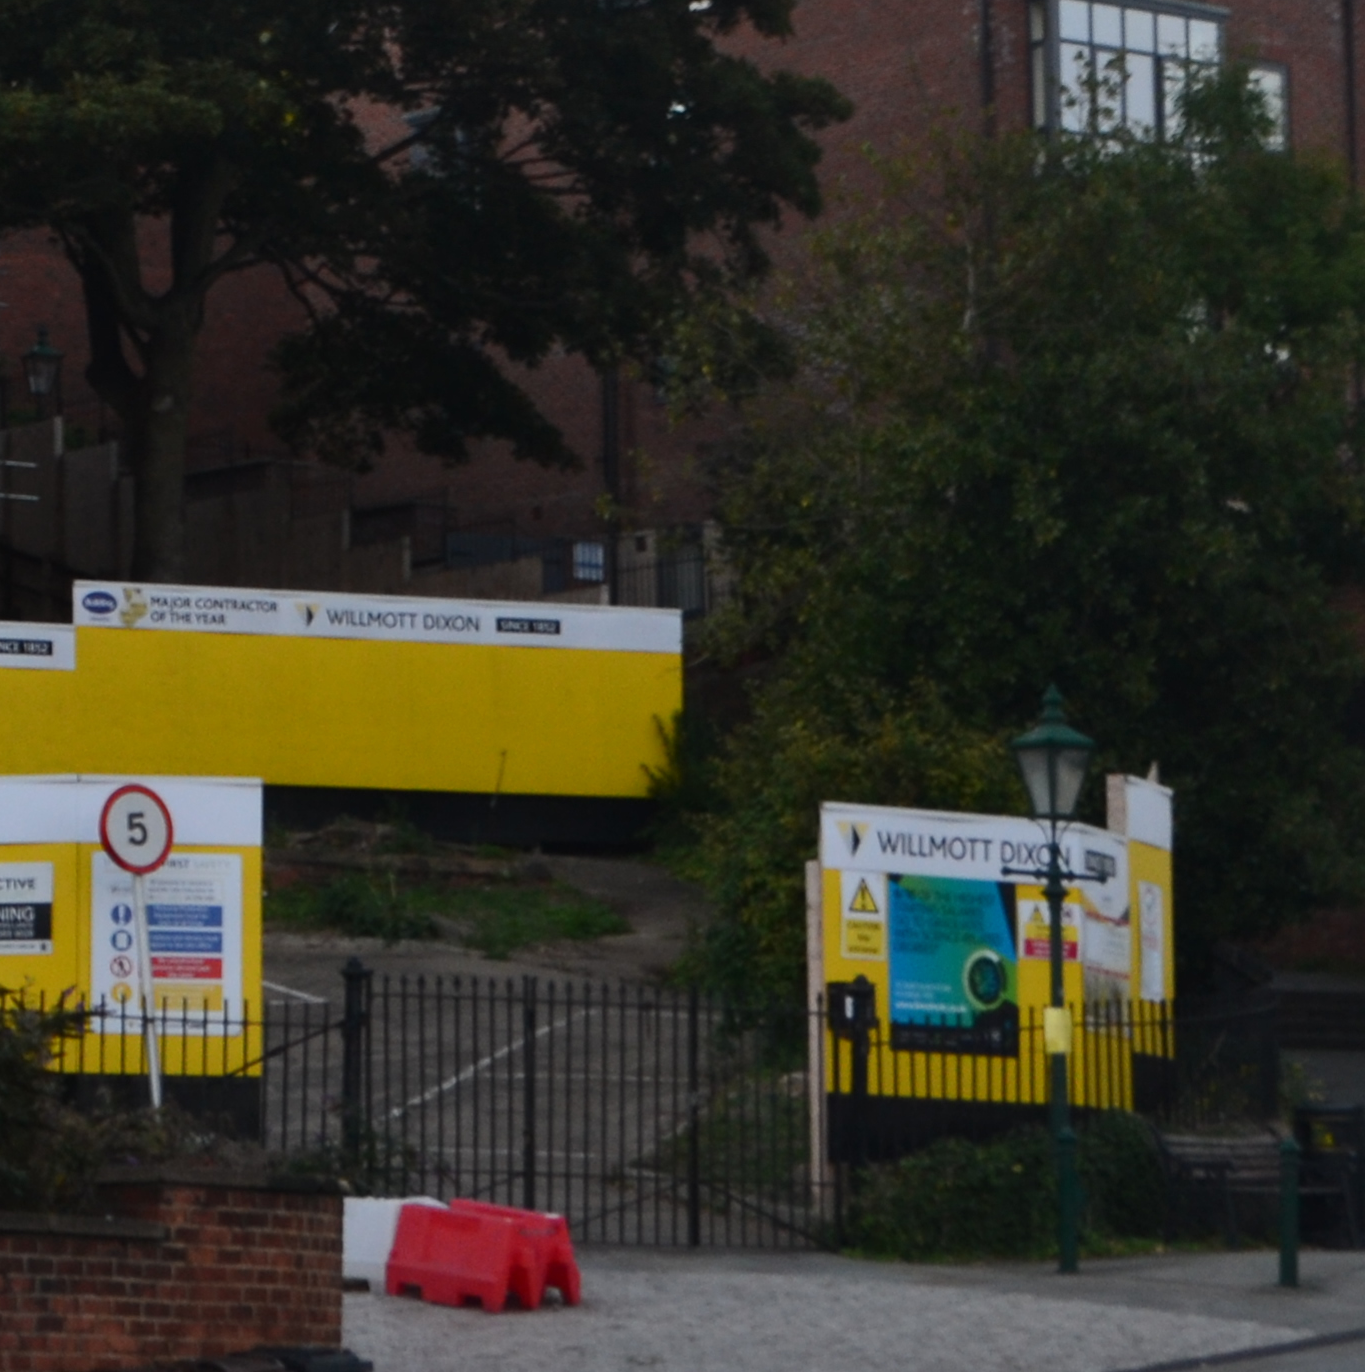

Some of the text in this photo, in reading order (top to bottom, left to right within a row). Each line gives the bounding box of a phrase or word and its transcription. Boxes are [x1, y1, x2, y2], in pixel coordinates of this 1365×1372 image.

[150, 597, 278, 613] MAJOR CONTRACTOR
[150, 612, 226, 625] OF THE YEAR
[326, 609, 418, 629] WILLMOTT
[423, 613, 481, 632] DIXON
[127, 812, 148, 845] 5
[877, 830, 993, 862] WILLMOTT
[1000, 841, 1071, 867] DIXON
